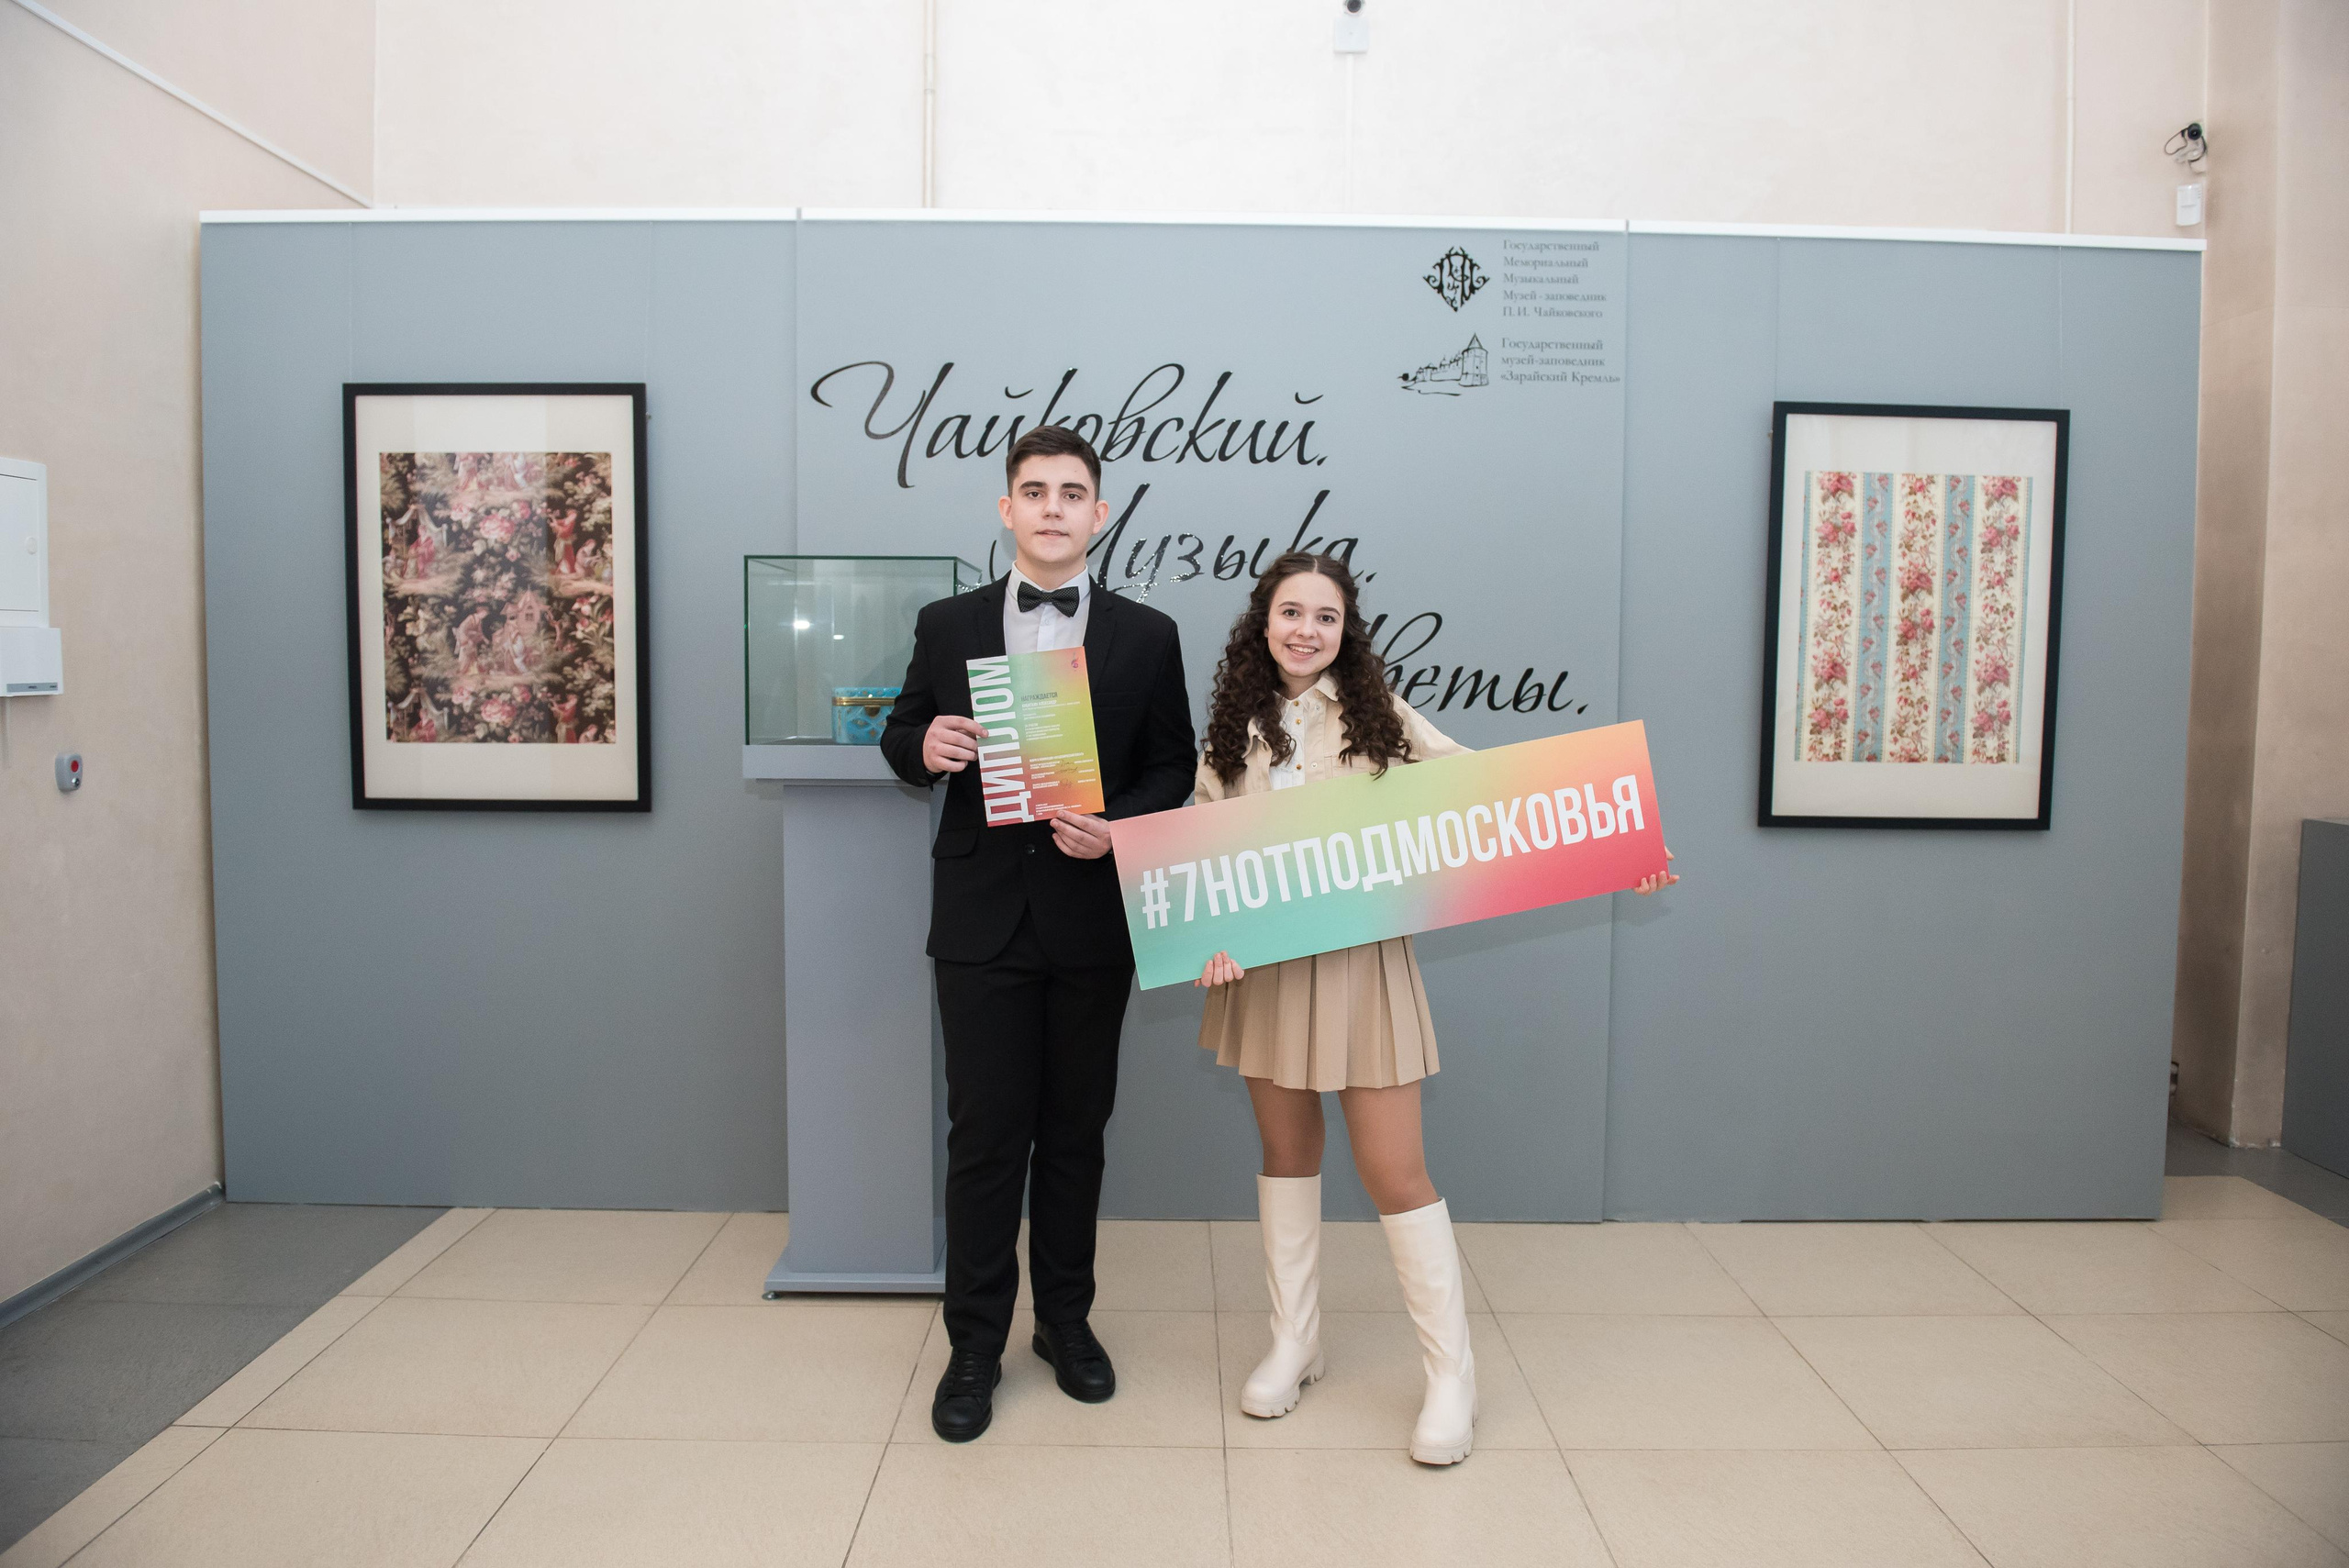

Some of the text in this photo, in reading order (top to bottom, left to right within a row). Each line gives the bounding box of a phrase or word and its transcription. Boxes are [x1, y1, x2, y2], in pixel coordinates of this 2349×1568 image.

[1503, 239, 1599, 253] Государственный
[1503, 256, 1588, 270] Мемориальный
[1503, 272, 1579, 285] Музыкальный
[1534, 306, 1603, 317] Чайковского
[1501, 337, 1604, 352] Государственный
[1501, 354, 1606, 368] музей-заповедник
[1500, 370, 1621, 386] «Зарайский Кремль»
[1365, 612, 1589, 715] веты.
[1020, 692, 1058, 702] НАГРАЖДАЕТСЯ
[966, 655, 1034, 823] ДИПЛОМ
[1140, 774, 1645, 930] #7НОТПОДМОСКОВЬЯ
